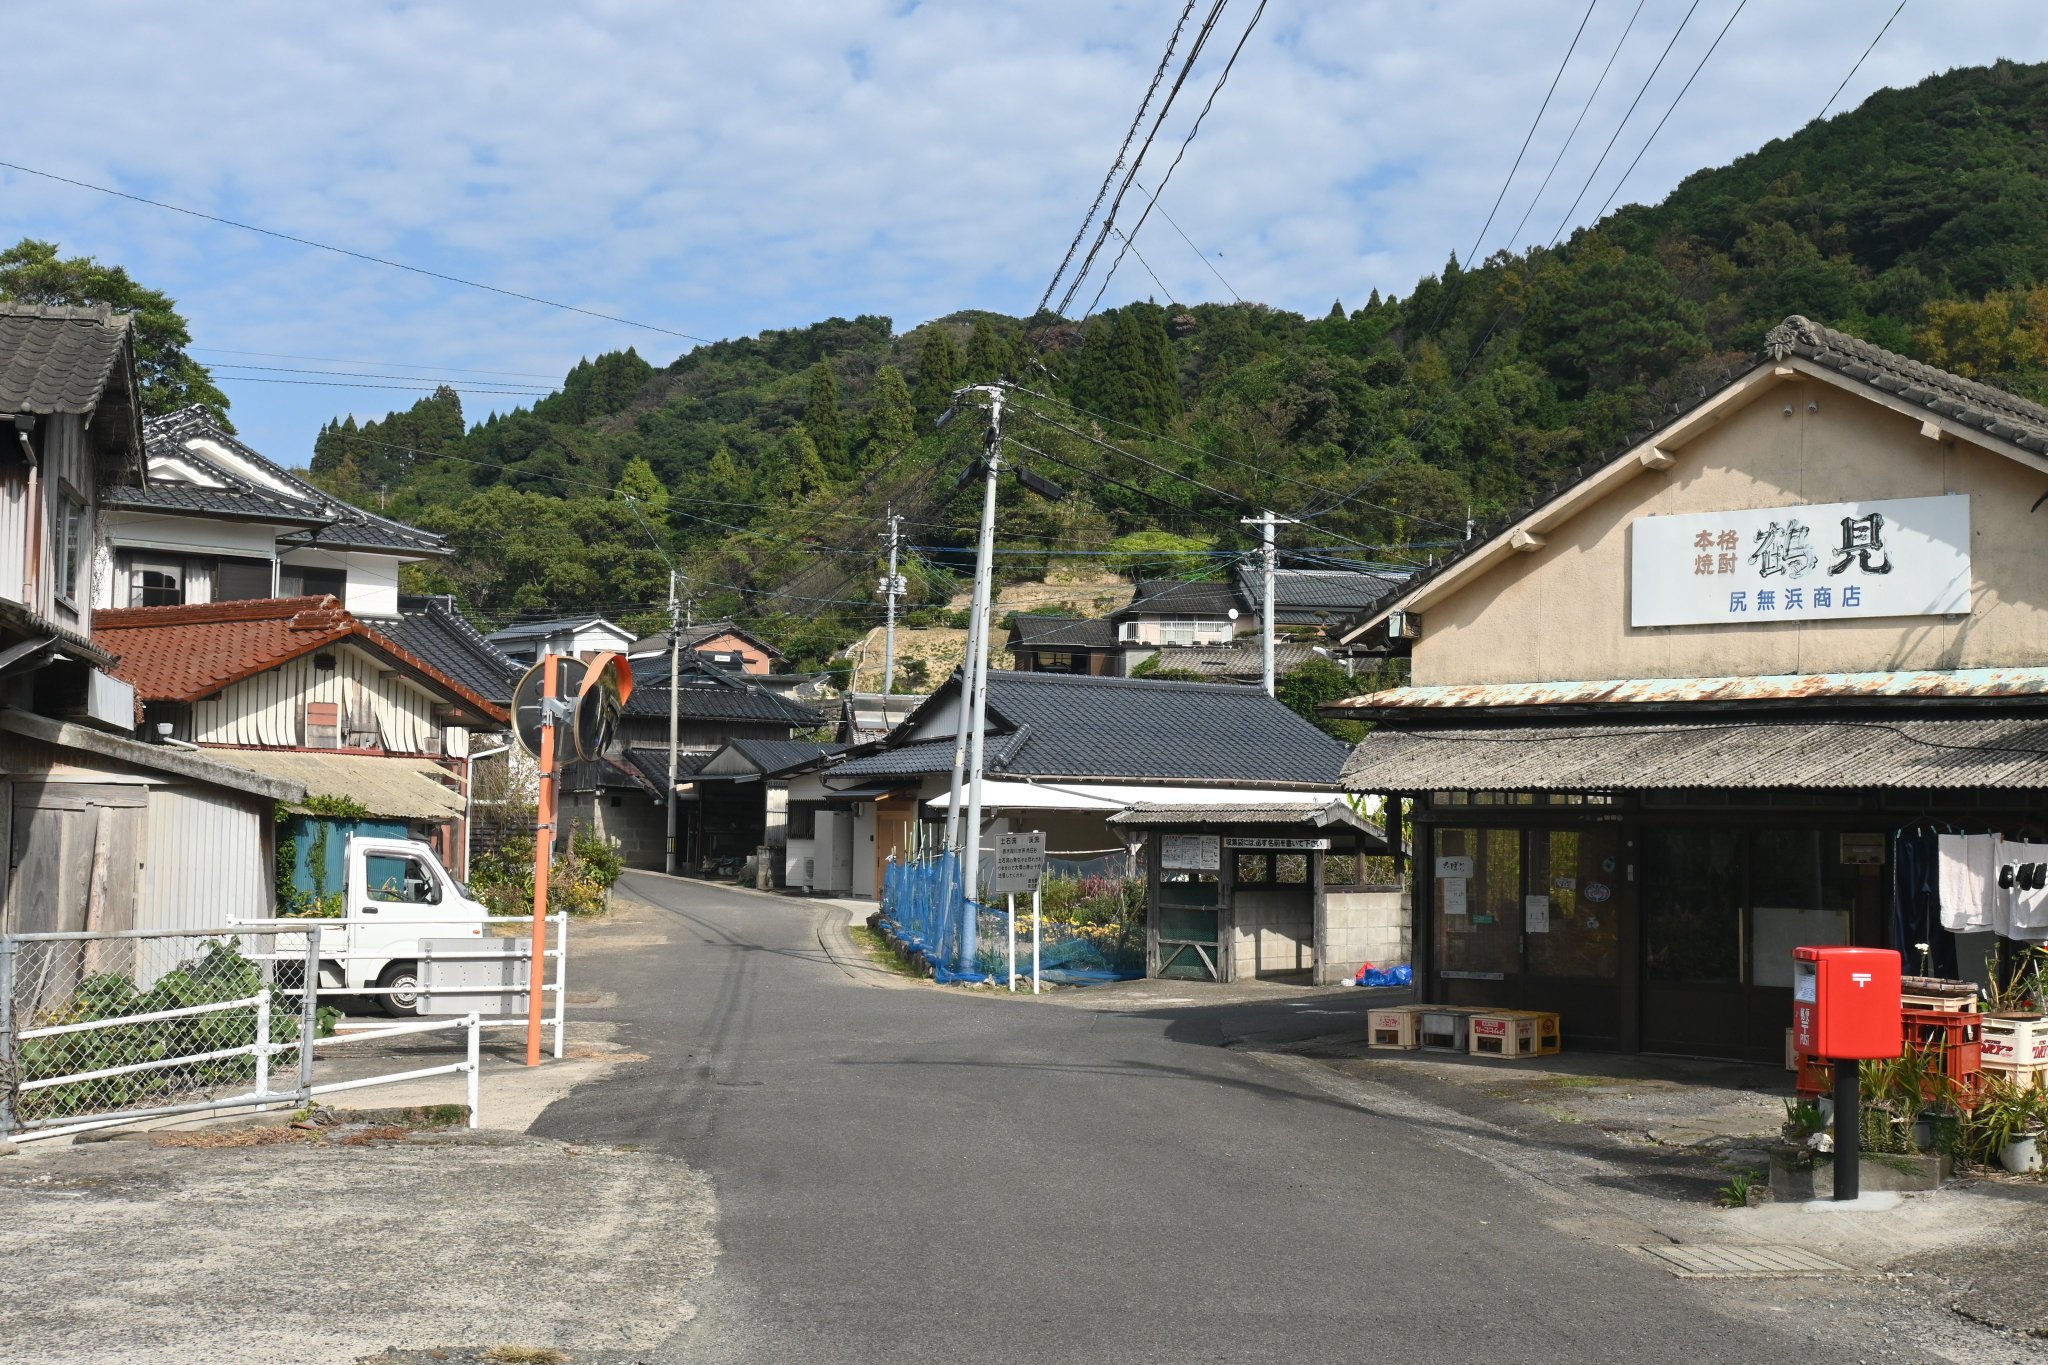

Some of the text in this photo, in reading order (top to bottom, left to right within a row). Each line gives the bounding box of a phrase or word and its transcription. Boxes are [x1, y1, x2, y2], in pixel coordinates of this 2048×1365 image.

[1694, 529, 1739, 551] 本格
[1748, 512, 1894, 580] 鶴見
[1694, 553, 1739, 576] 焼酎
[1729, 585, 1861, 613] 尻無浜商店
[1475, 1026, 1505, 1035] アサヒビール
